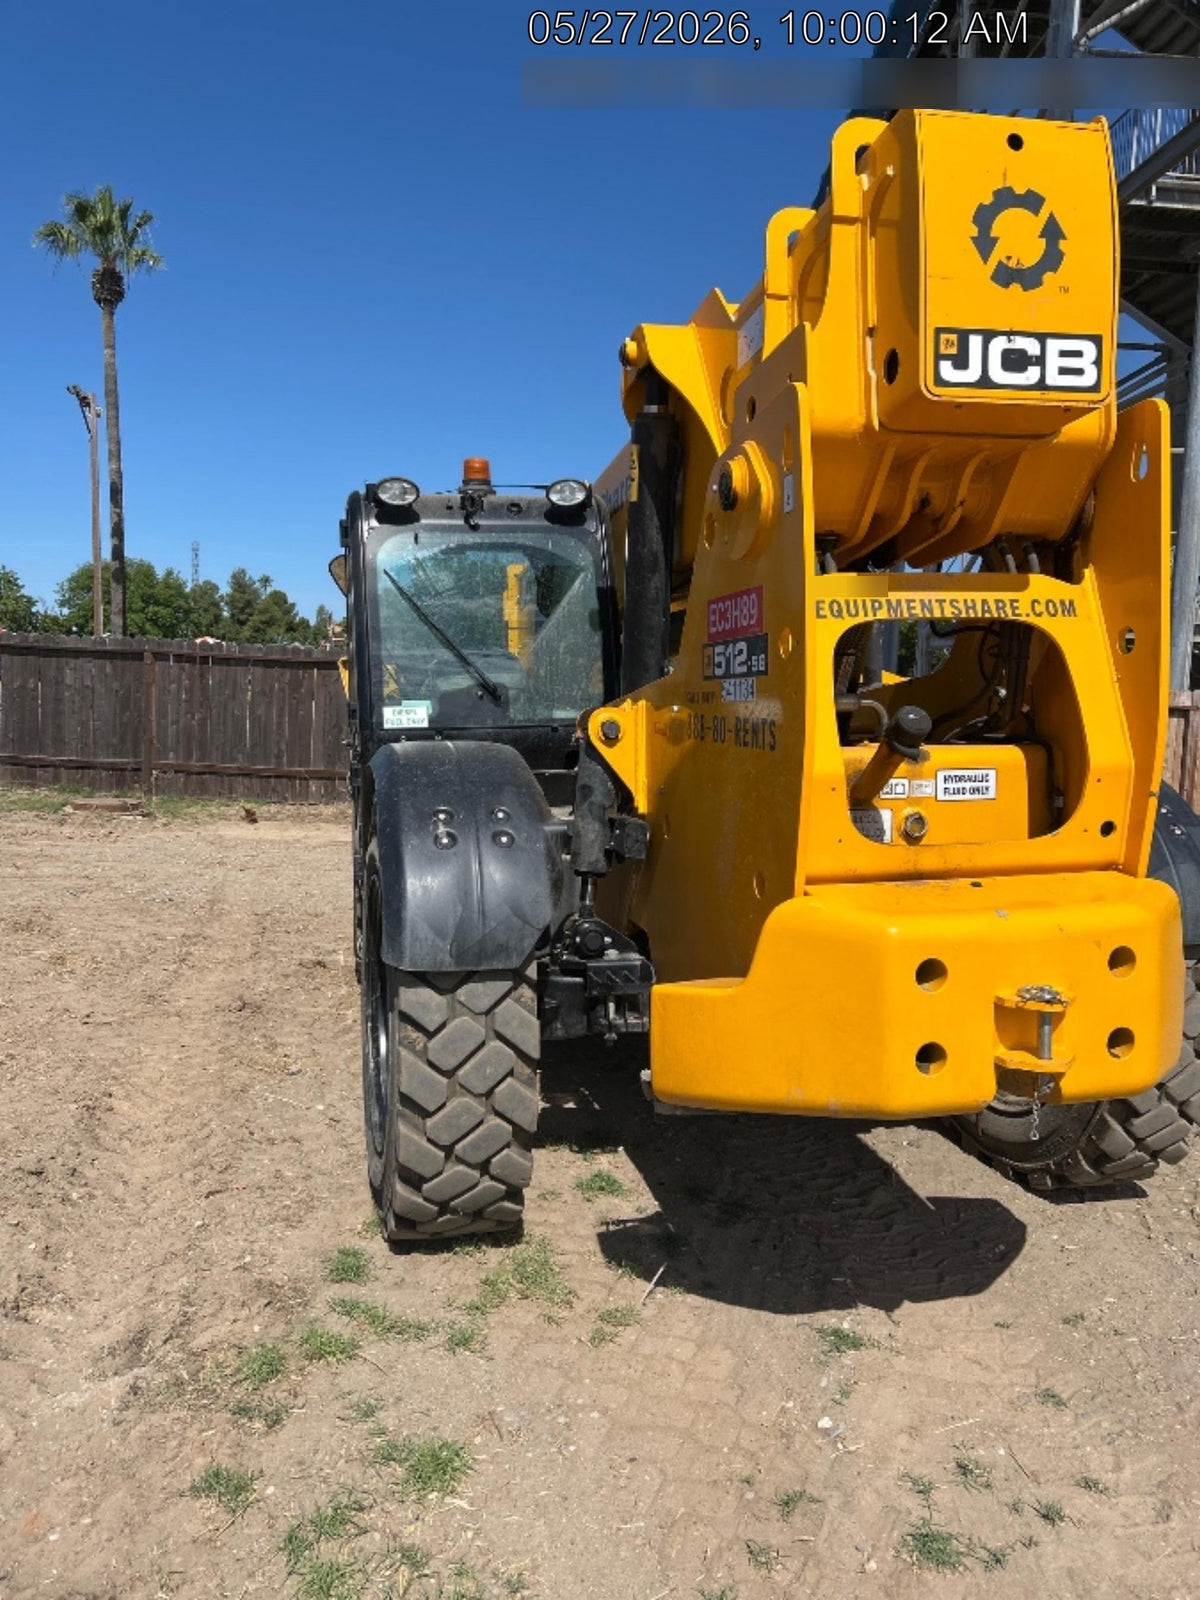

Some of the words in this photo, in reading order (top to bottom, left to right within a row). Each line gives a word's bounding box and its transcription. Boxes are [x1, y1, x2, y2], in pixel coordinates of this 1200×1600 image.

[939, 333, 1098, 387] JCB
[709, 593, 758, 634] EC3H89
[815, 598, 1078, 620] EQUIPMENTSHARE.COM
[943, 773, 989, 784] HYDRAULIC
[943, 787, 966, 796] FLUID
[968, 786, 990, 795] ONLY
